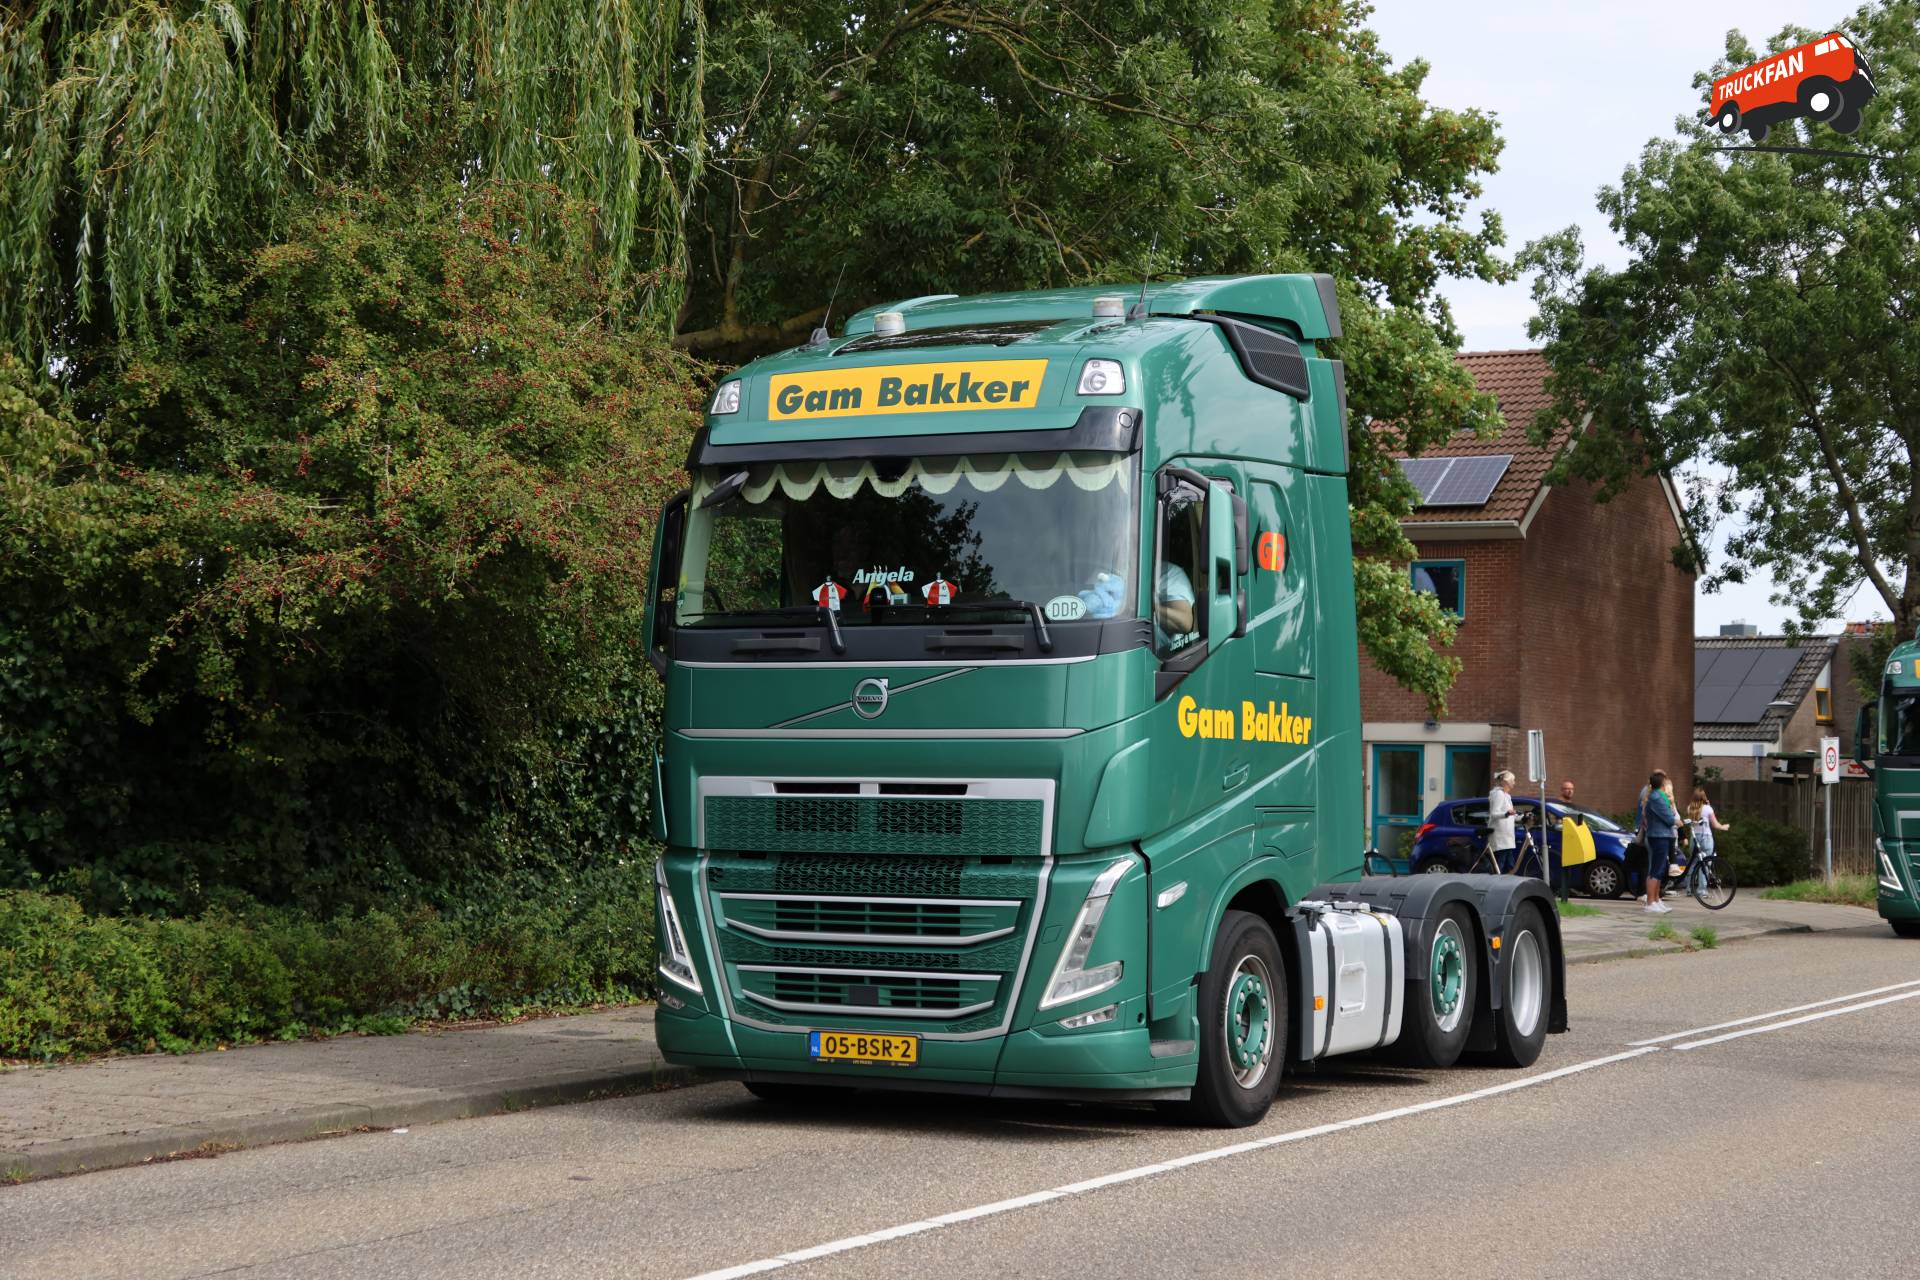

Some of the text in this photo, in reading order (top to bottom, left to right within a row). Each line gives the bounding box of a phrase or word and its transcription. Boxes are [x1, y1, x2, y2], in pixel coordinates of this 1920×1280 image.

[776, 372, 1030, 415] Gam Bakker
[852, 566, 915, 586] Angela
[1052, 602, 1078, 617] DDR
[1177, 695, 1312, 745] Gam Bakker
[825, 1036, 911, 1058] 05-BSR-2
